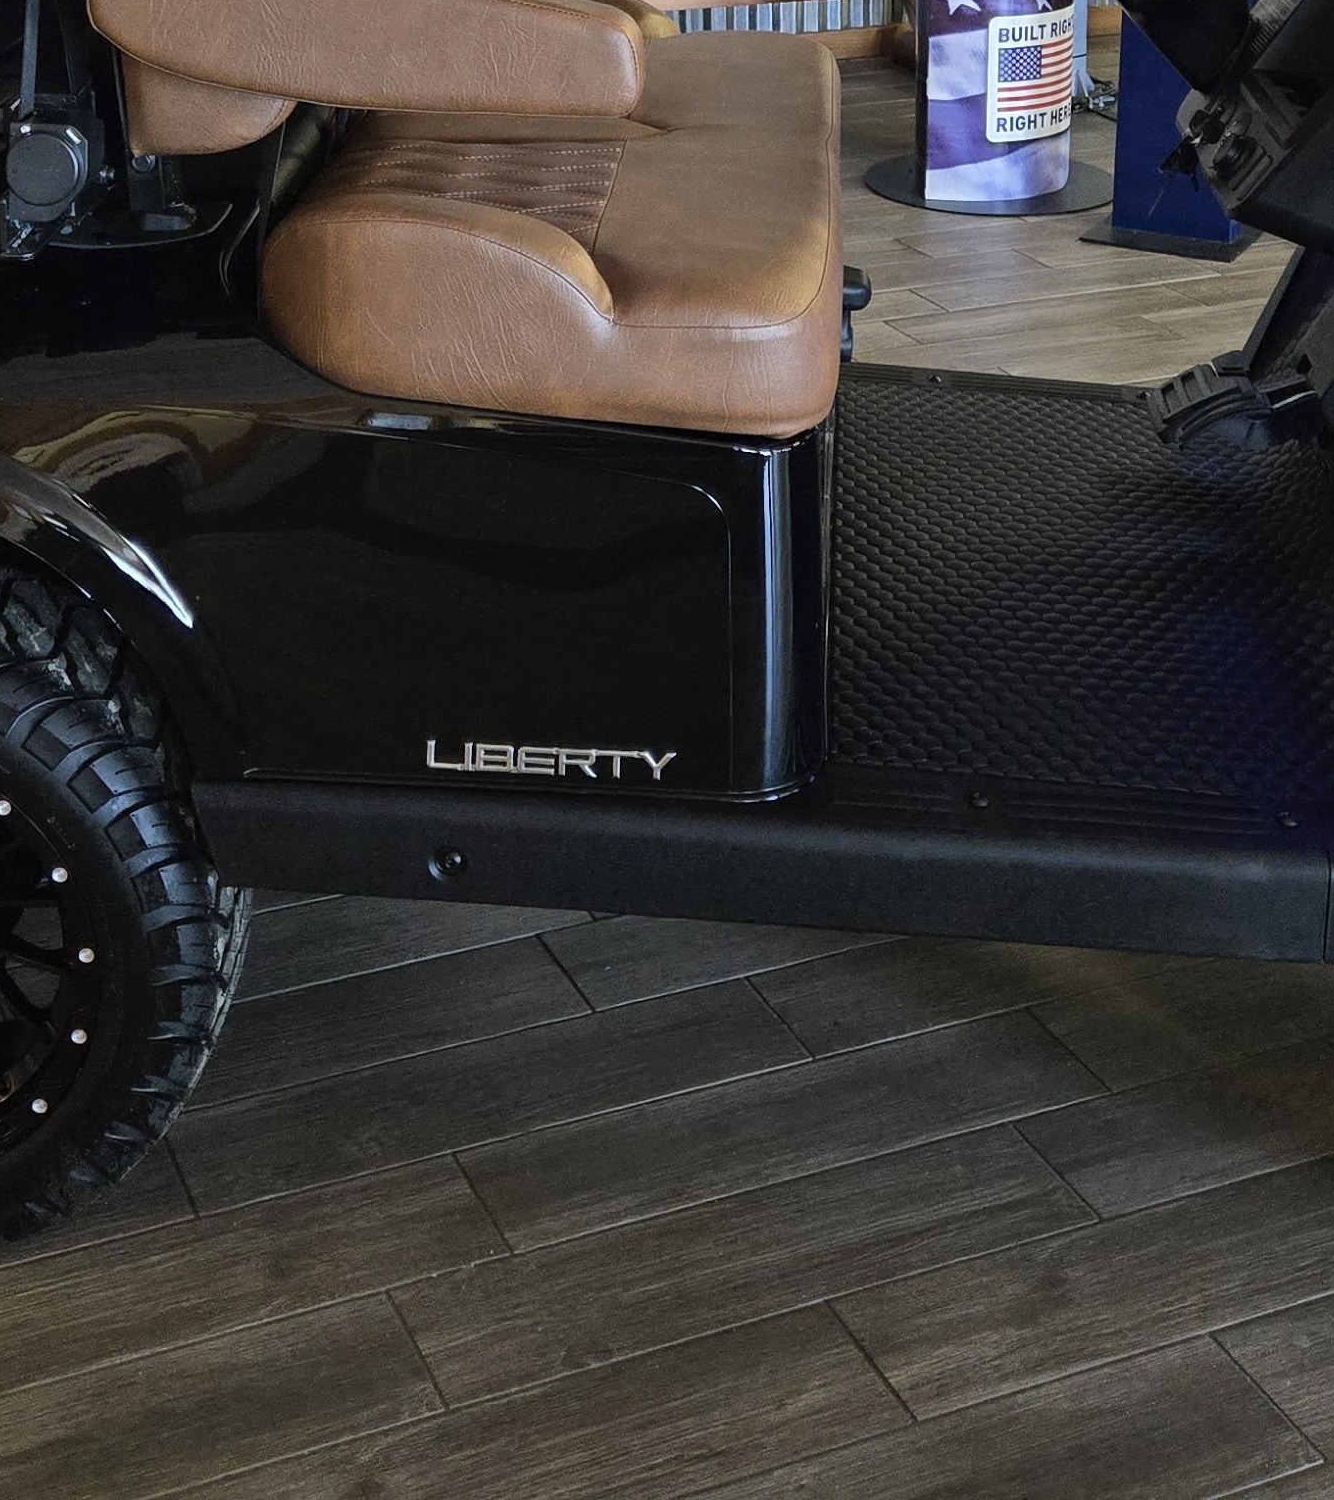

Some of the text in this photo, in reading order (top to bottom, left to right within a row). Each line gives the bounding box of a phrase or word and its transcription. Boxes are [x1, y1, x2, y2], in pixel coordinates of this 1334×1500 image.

[998, 24, 1047, 43] BUILT
[996, 112, 1047, 133] RIGHT
[426, 739, 677, 781] LIBERTY
